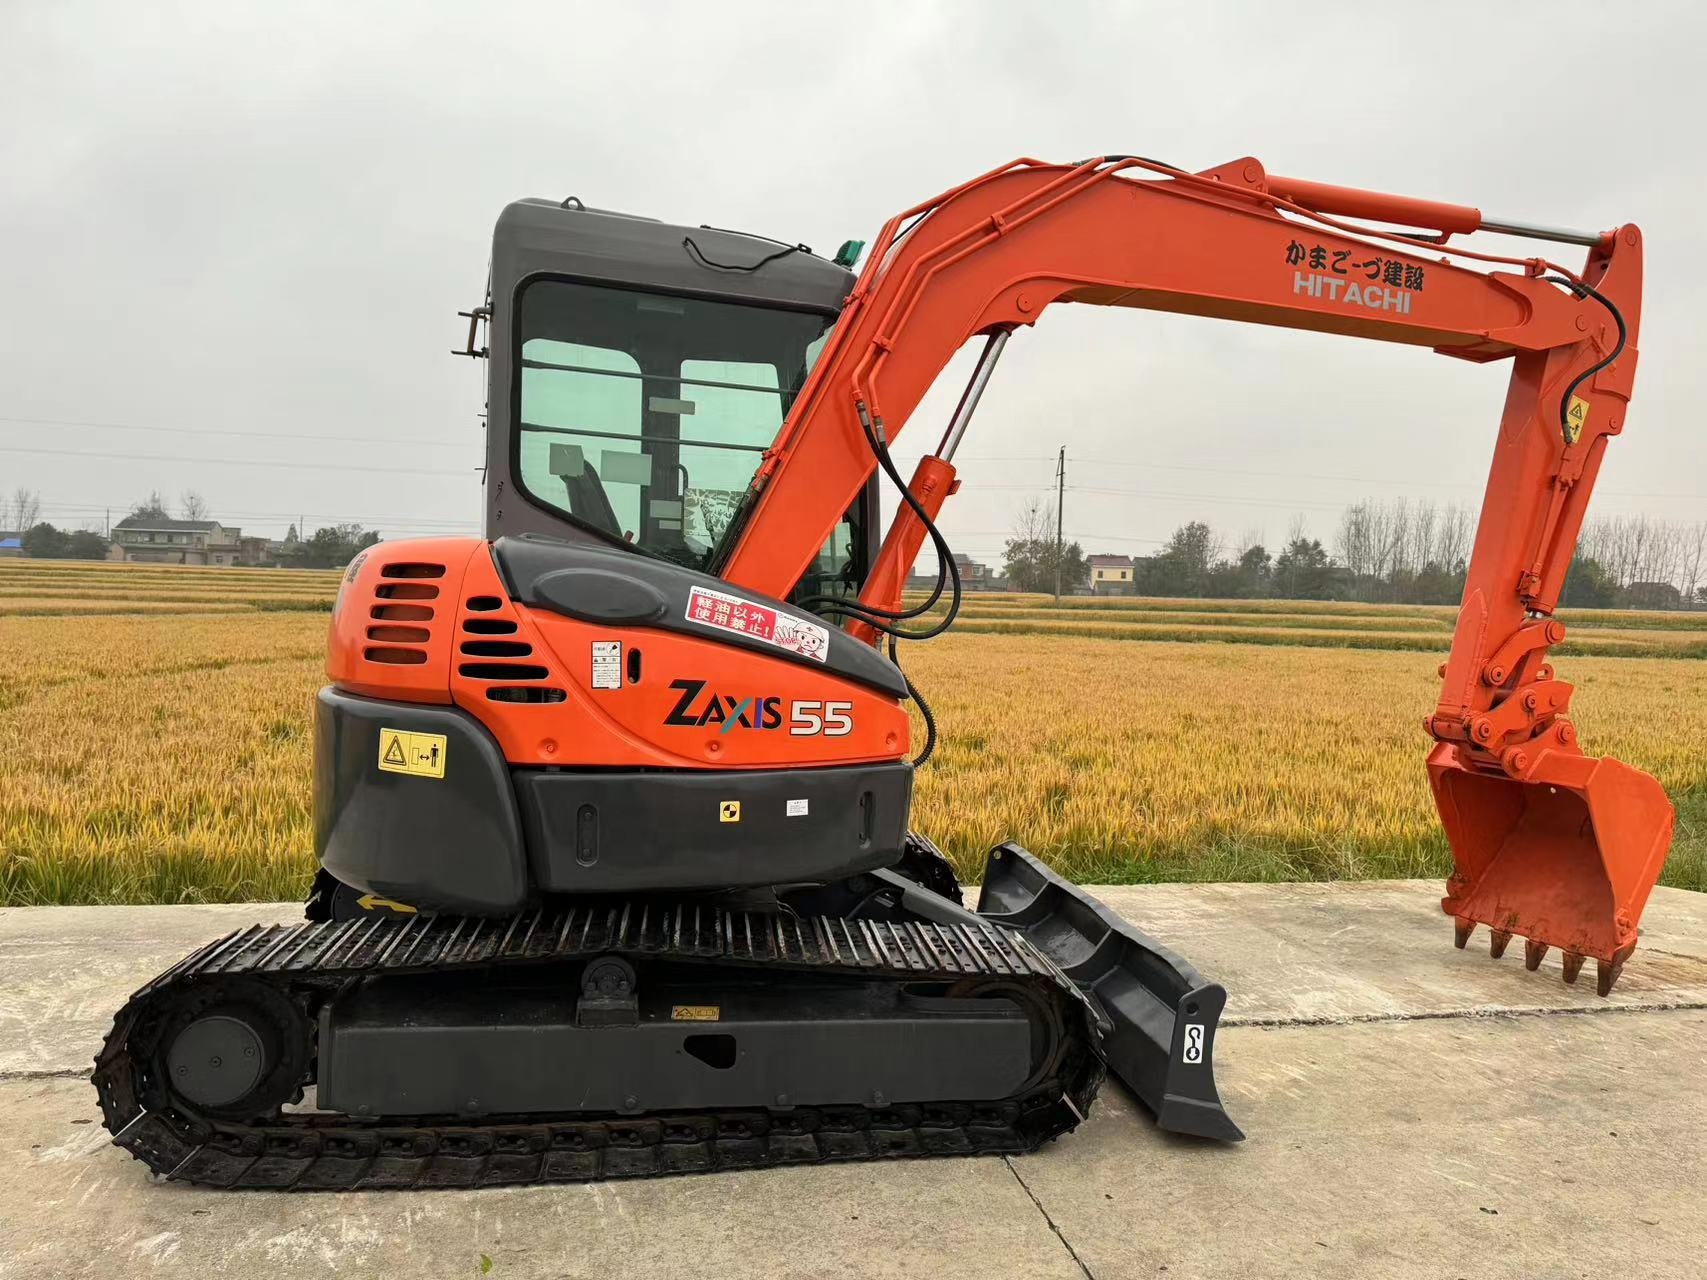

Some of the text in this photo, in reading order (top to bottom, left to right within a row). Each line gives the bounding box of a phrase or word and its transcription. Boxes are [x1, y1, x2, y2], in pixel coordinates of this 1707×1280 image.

[1293, 271, 1412, 314] HITACHI
[696, 596, 766, 622] 軽油以外
[663, 679, 853, 737] ZAXIS 55
